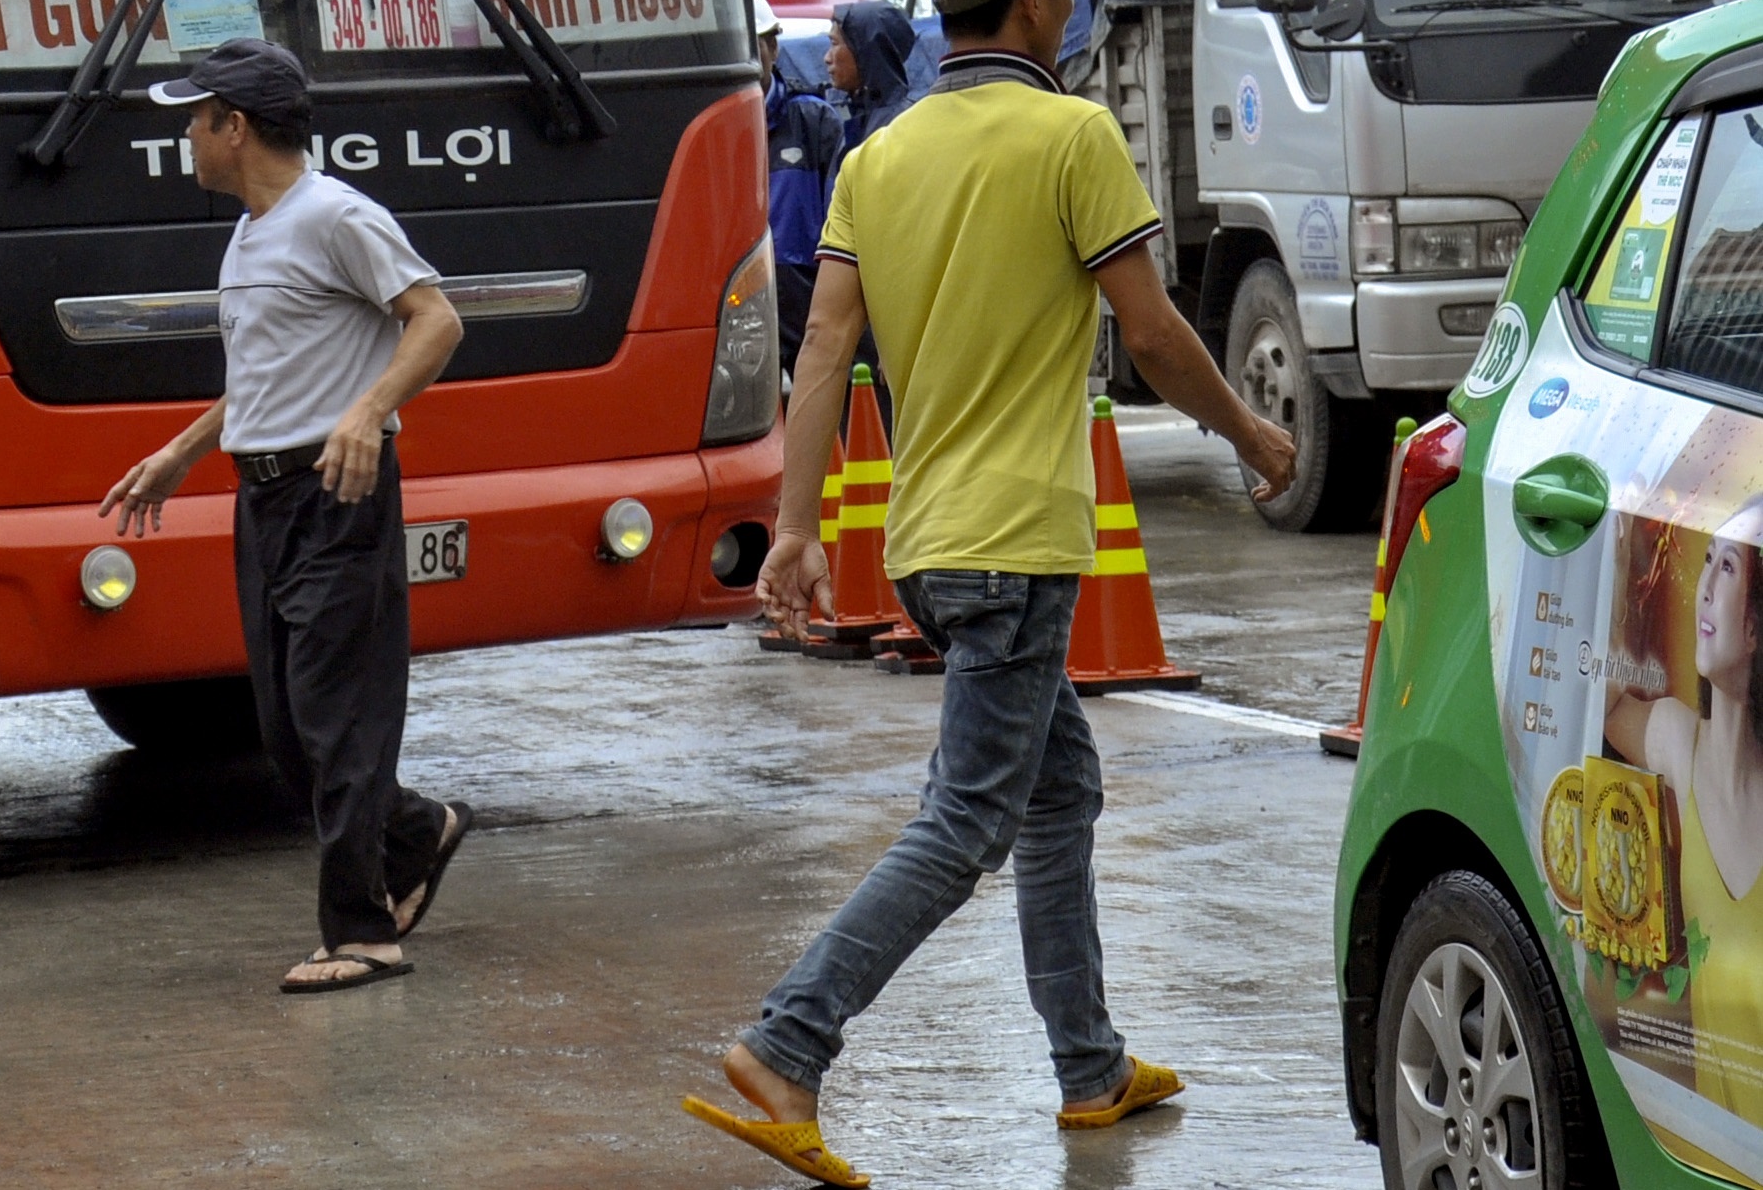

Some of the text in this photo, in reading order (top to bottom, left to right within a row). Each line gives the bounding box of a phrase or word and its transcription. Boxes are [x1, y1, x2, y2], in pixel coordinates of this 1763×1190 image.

[405, 125, 511, 182] LỢI
[1532, 388, 1565, 408] MEGA
[1610, 807, 1629, 826] NNO
